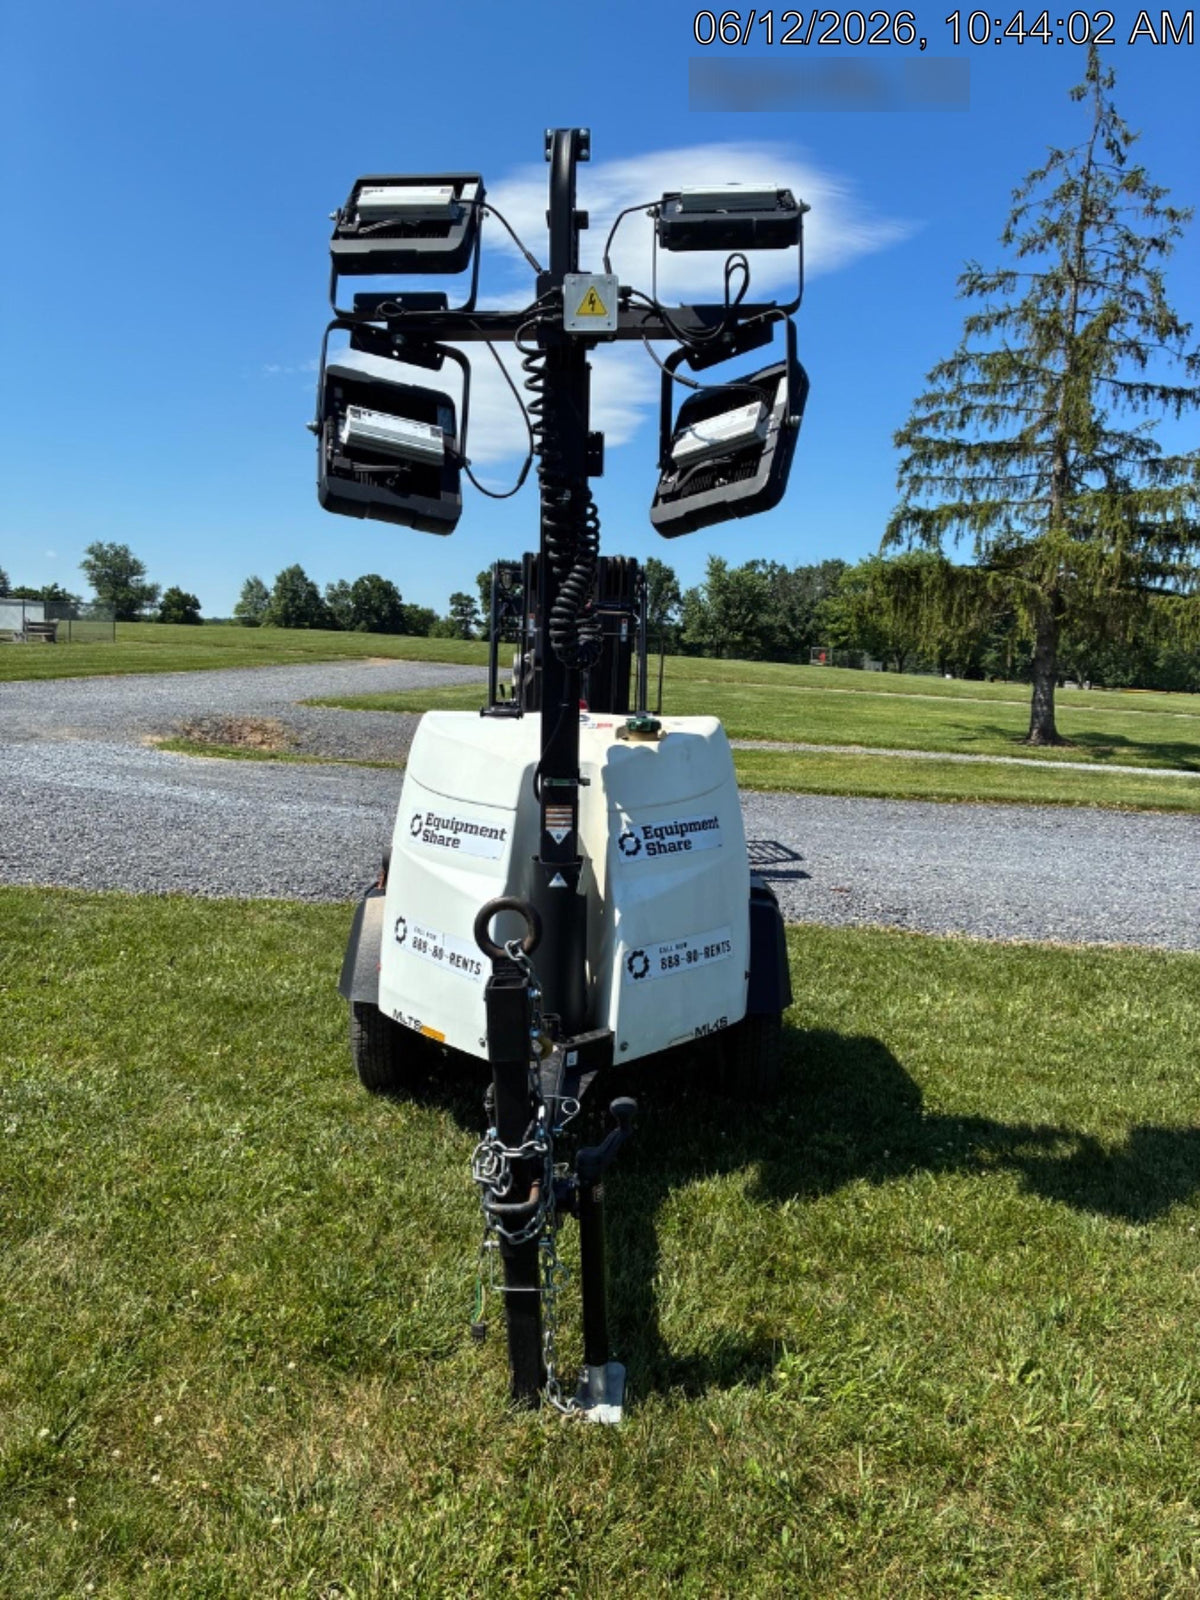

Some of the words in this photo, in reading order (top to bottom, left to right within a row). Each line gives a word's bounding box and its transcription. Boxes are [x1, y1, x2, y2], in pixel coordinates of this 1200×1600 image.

[422, 828, 461, 849] Share
[425, 812, 507, 841] Equipment
[641, 816, 720, 840] Equipment
[645, 839, 692, 856] Share
[412, 936, 482, 975] 888-80-RENTS
[660, 940, 732, 970] 888-80-RENTS
